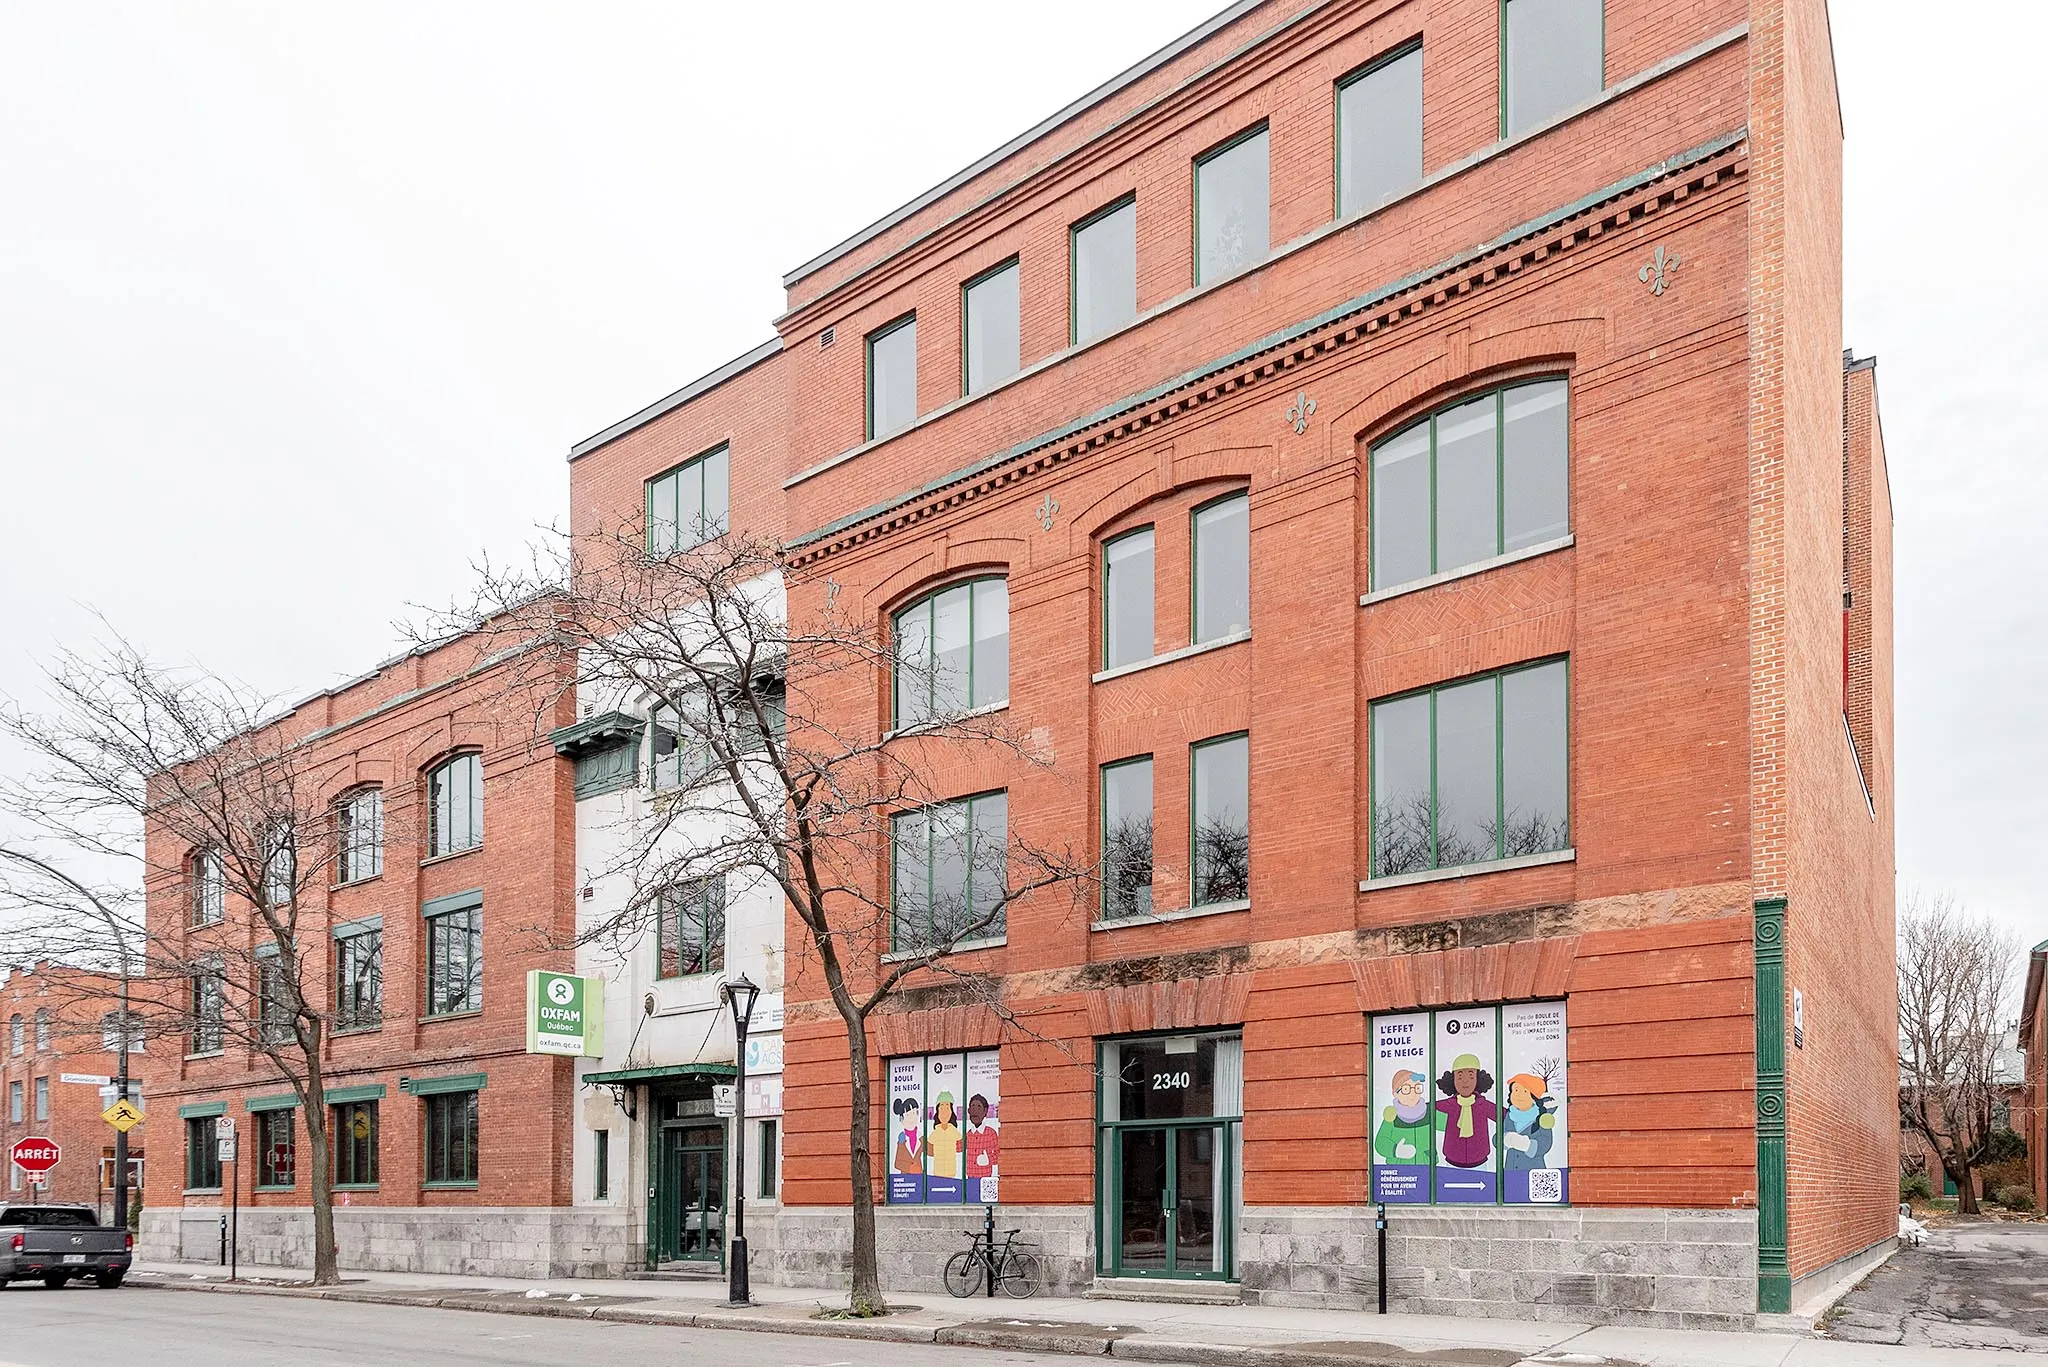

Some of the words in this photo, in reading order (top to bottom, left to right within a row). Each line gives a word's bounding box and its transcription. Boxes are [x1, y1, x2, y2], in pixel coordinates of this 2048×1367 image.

[541, 1006, 581, 1022] OXFAM
[546, 1021, 574, 1032] Québec
[1380, 1023, 1414, 1035] L'EFFET
[1463, 1021, 1486, 1030] OXFAM
[539, 1039, 582, 1049] oxfam.qc.ca
[1380, 1036, 1412, 1046] BOULE
[1380, 1049, 1392, 1058] DE
[1394, 1047, 1424, 1058] NEIGE
[894, 1065, 916, 1074] L'EFFET
[894, 1075, 914, 1083] BOULE
[1153, 1071, 1191, 1090] 2340
[721, 1087, 730, 1098] P
[902, 1083, 921, 1092] NEIGE
[14, 1147, 59, 1160] ARRÊT
